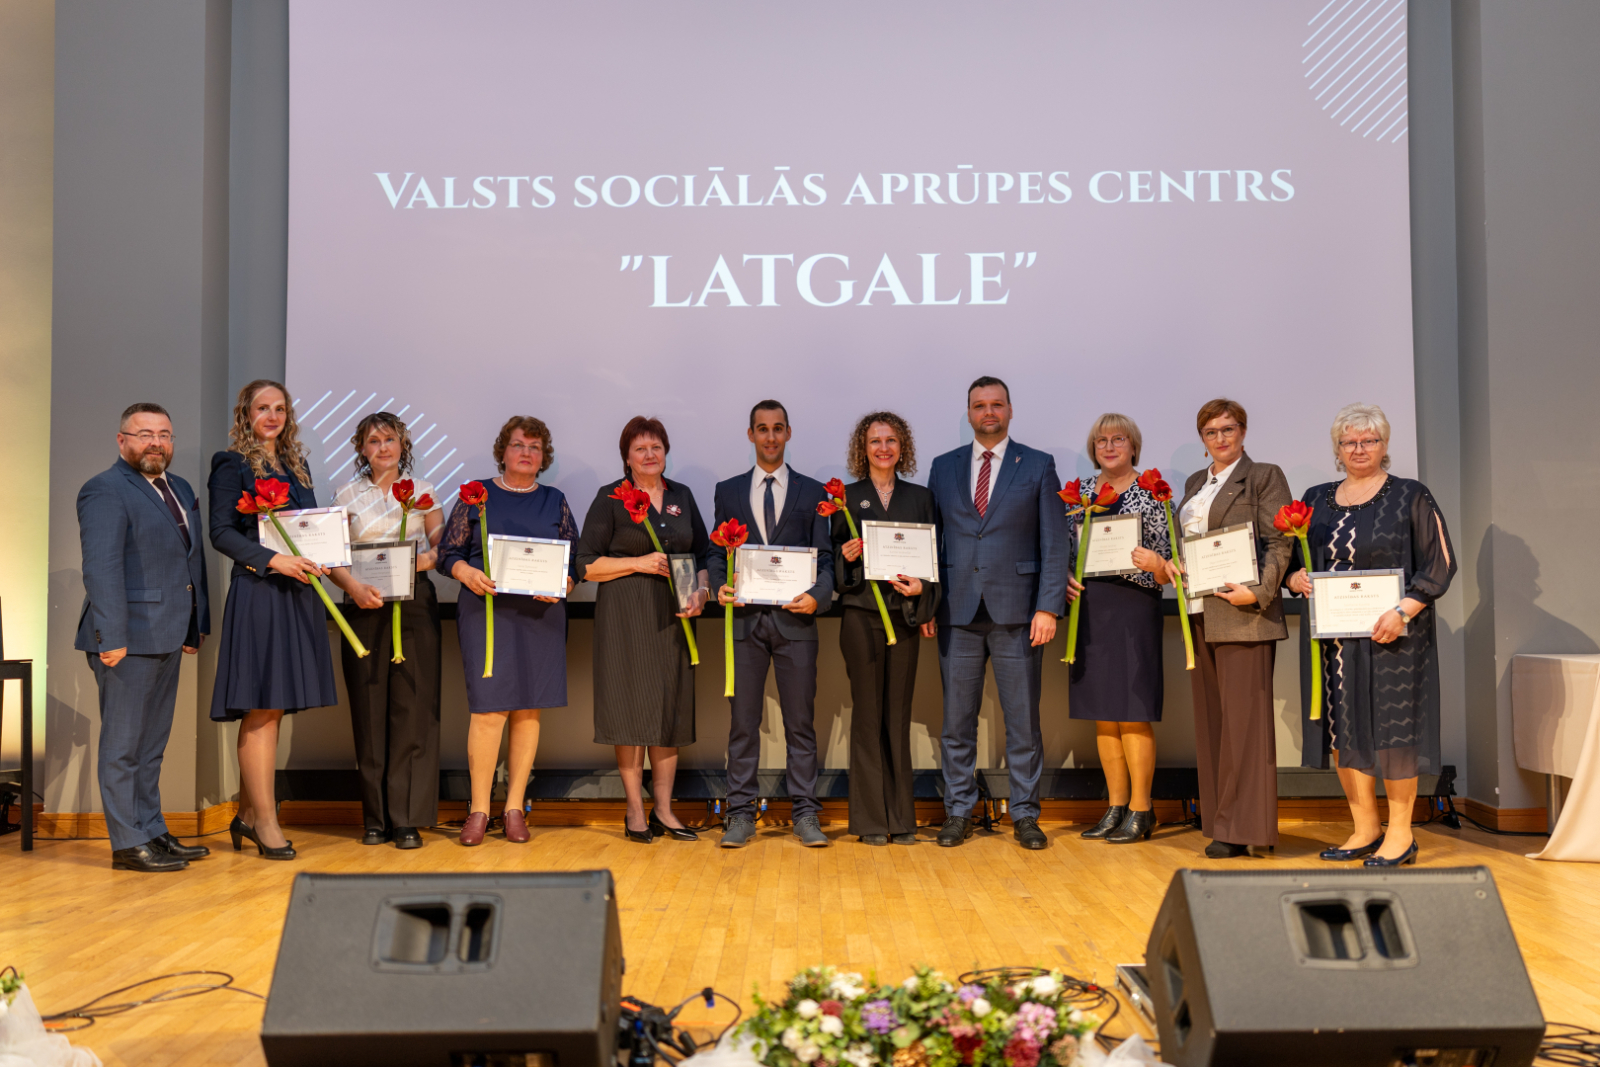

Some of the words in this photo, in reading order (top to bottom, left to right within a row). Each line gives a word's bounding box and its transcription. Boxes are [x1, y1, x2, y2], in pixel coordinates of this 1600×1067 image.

[374, 172, 556, 210] VALSTS
[573, 165, 827, 208] SOCIĀLĀS
[843, 164, 1073, 206] APRŪPES
[1088, 168, 1295, 204] CENTRS
[619, 251, 1037, 308] "LATGALE"
